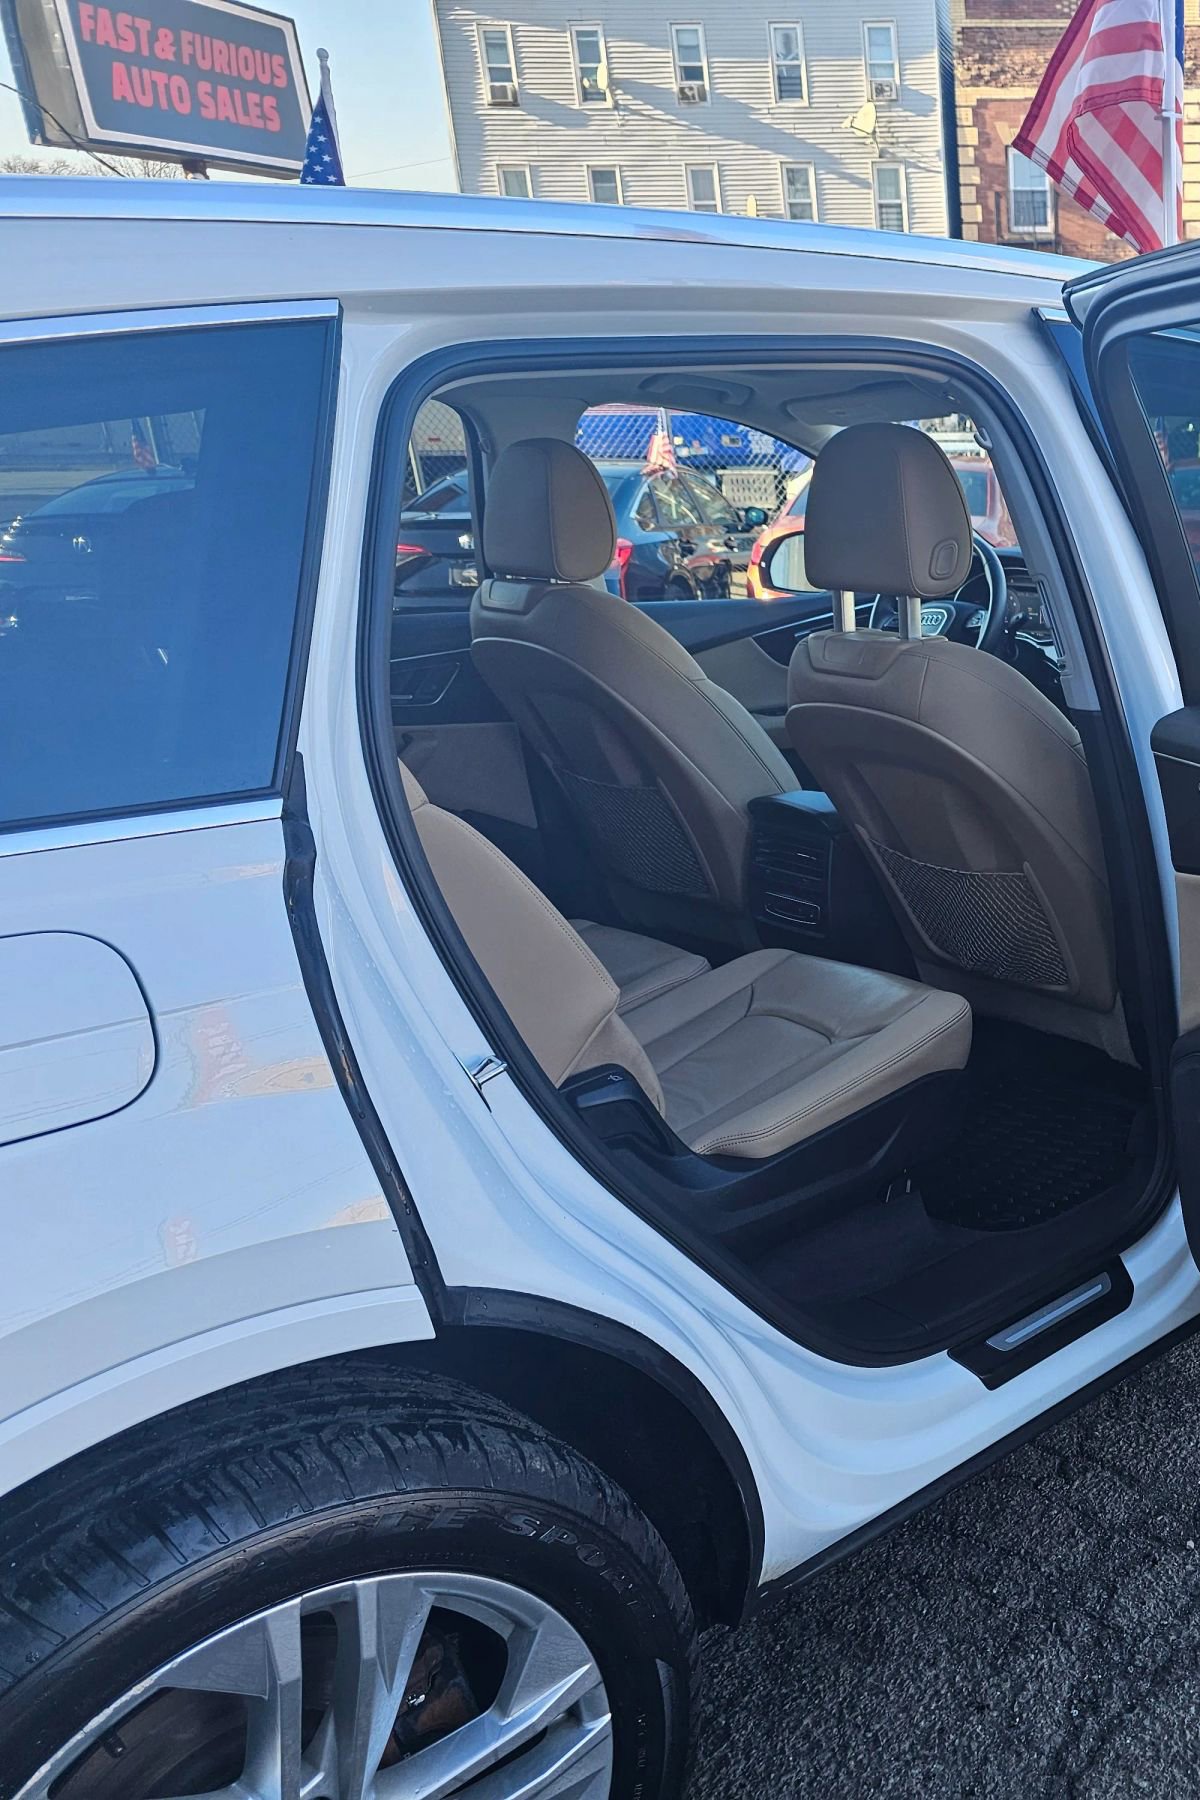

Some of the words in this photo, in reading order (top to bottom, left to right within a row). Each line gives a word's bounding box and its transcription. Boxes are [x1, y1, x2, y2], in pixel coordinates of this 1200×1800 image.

[78, 2, 152, 56] FAST
[153, 27, 177, 62] &
[180, 31, 288, 88] FURIOUS
[111, 61, 192, 115] AUTO
[198, 81, 281, 132] SALES
